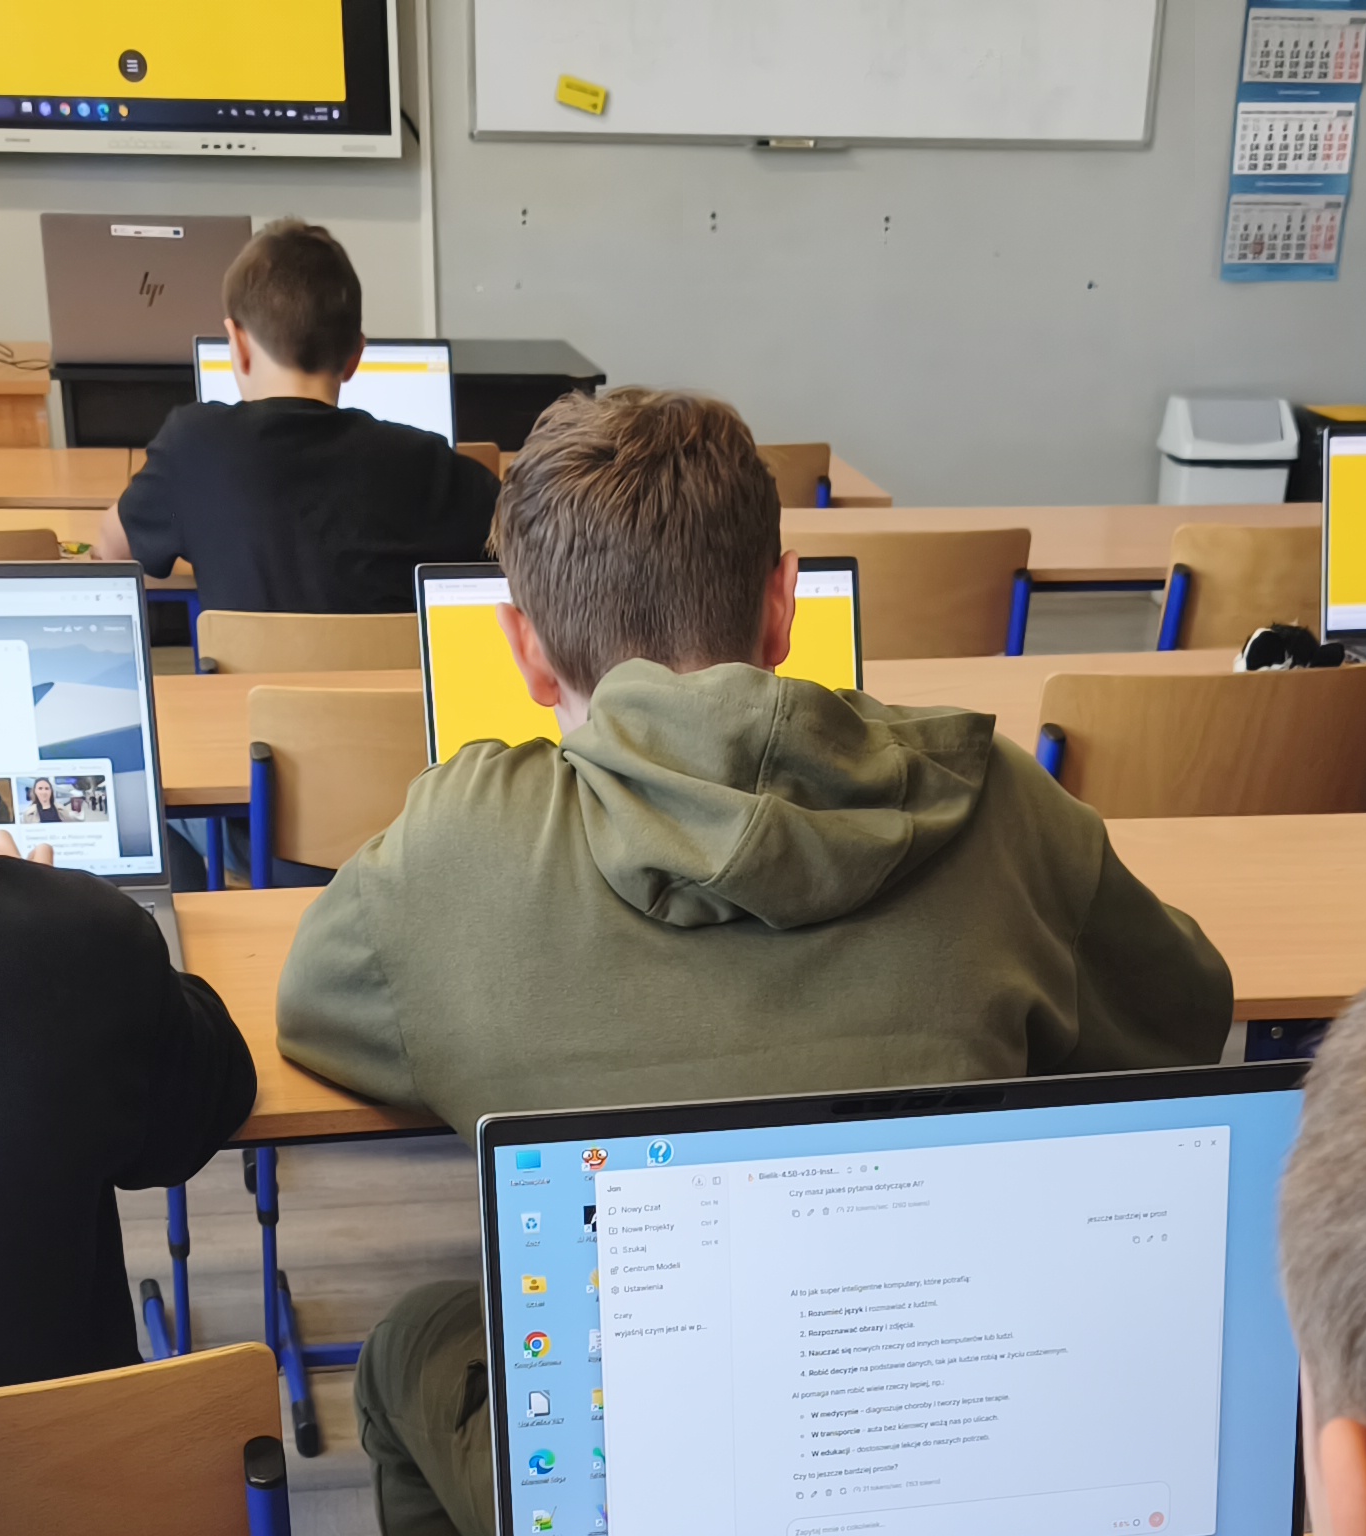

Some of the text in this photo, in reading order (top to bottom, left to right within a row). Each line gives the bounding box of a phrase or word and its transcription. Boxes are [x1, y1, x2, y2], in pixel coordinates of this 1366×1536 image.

[825, 1186, 845, 1195] jakieś
[848, 1184, 873, 1194] pytania
[875, 1182, 911, 1191] dotyczące
[622, 1204, 661, 1214] Nowy Czat
[645, 1223, 674, 1232] Projekty
[623, 1245, 646, 1253] Szukaj
[657, 1262, 680, 1270] Modeli
[624, 1284, 663, 1293] Ustawienia
[808, 1289, 818, 1297] jak
[820, 1286, 840, 1295] super
[842, 1284, 882, 1293] inteligentne
[883, 1280, 921, 1288] komputery,
[808, 1308, 843, 1317] Rozumieć
[844, 1307, 863, 1316] język
[615, 1329, 643, 1338] wyjaśnij
[666, 1325, 678, 1334] jest
[809, 1327, 857, 1336] Rozpoznawać
[859, 1324, 883, 1332] obrazy
[809, 1348, 839, 1356] Nauczać
[853, 1345, 880, 1353] nowych
[882, 1342, 904, 1350] rzeczy
[917, 1339, 939, 1347] innych
[941, 1336, 982, 1344] komputerów
[809, 1368, 829, 1376] Robić
[830, 1366, 858, 1374] decyzje
[870, 1362, 905, 1372] podstawie
[907, 1360, 933, 1368] danych,
[801, 1391, 829, 1399] pomaga
[847, 1386, 864, 1394] robić
[820, 1409, 858, 1418] medycynie
[866, 1405, 902, 1414] diagnozuje
[962, 1397, 983, 1405] lepsze
[821, 1428, 860, 1437] transporcie
[898, 1422, 928, 1430] kierowcy
[821, 1448, 850, 1456] edukacji
[857, 1443, 900, 1452] dostosowuje
[933, 1437, 961, 1445] naszych
[817, 1470, 843, 1479] jeszcze
[844, 1466, 871, 1474] bardziej
